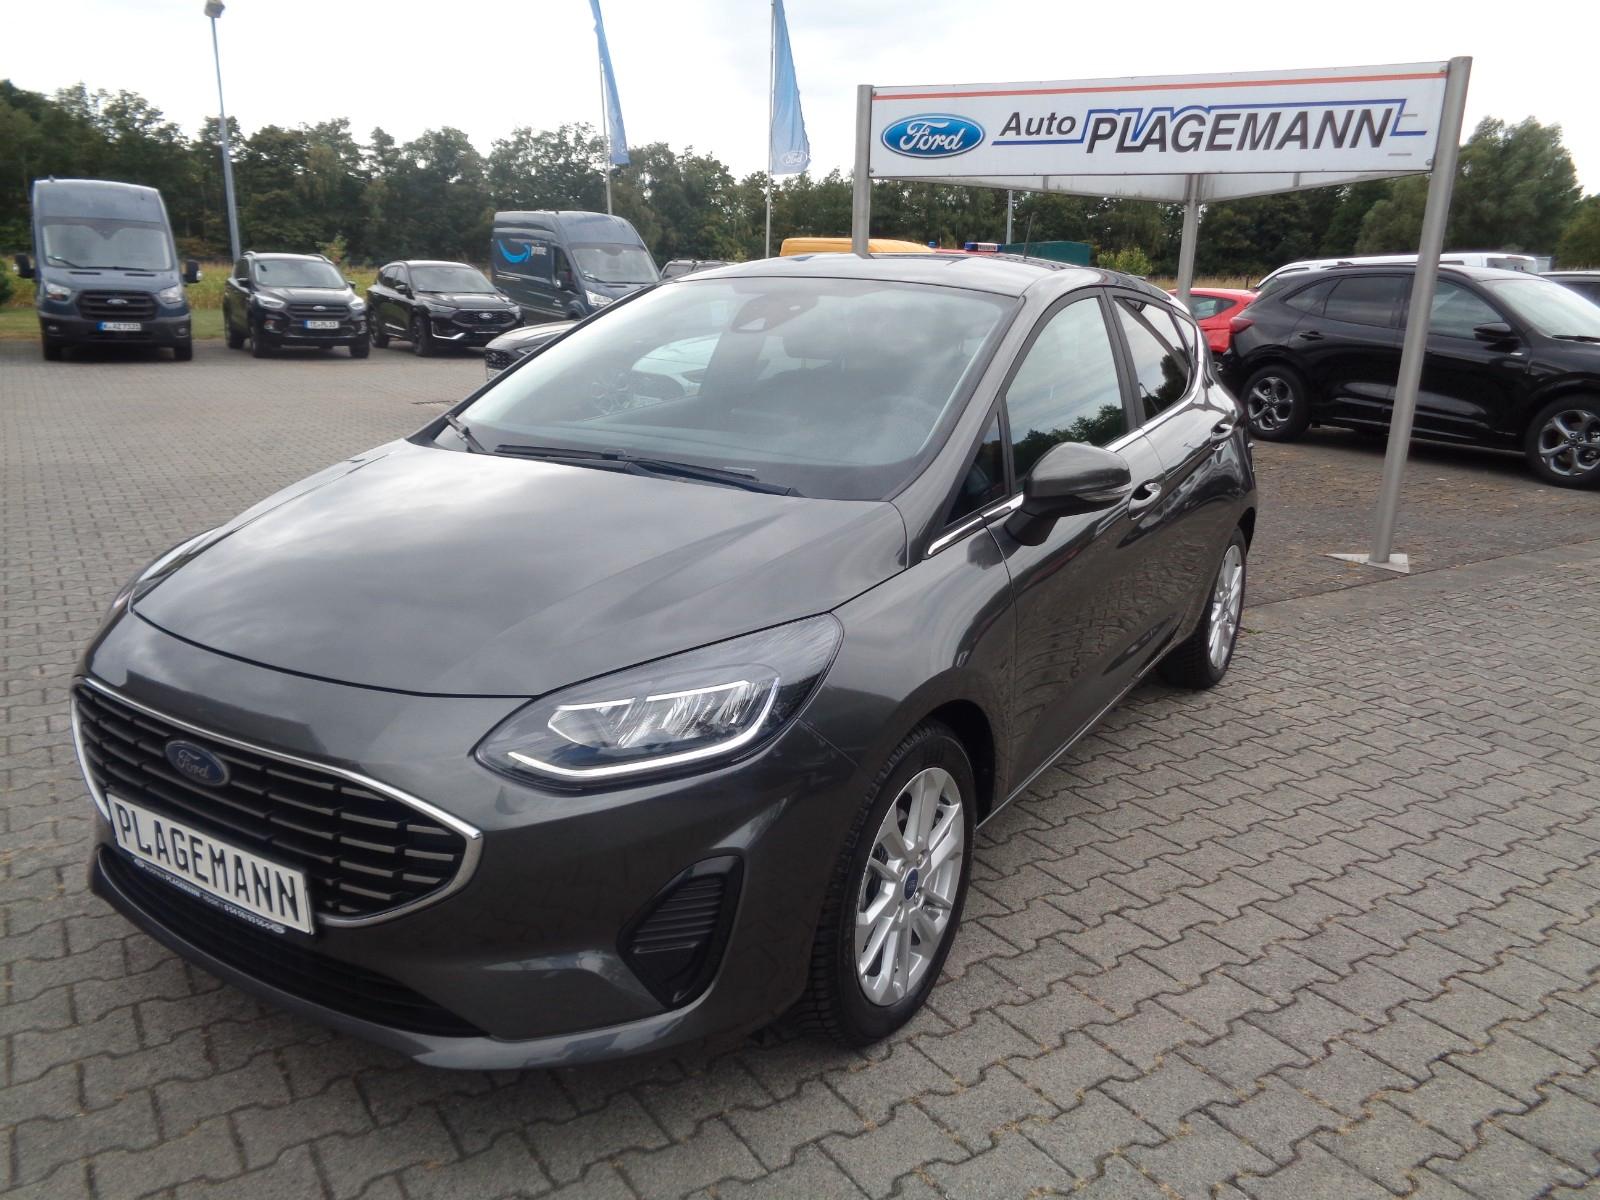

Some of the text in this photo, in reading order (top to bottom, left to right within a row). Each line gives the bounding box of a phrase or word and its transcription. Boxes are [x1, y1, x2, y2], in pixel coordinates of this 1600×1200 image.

[900, 121, 966, 150] Ford
[999, 107, 1393, 153] Auto PLAGEMANN
[175, 749, 210, 779] Ford
[113, 803, 300, 922] PLAGEMANN
